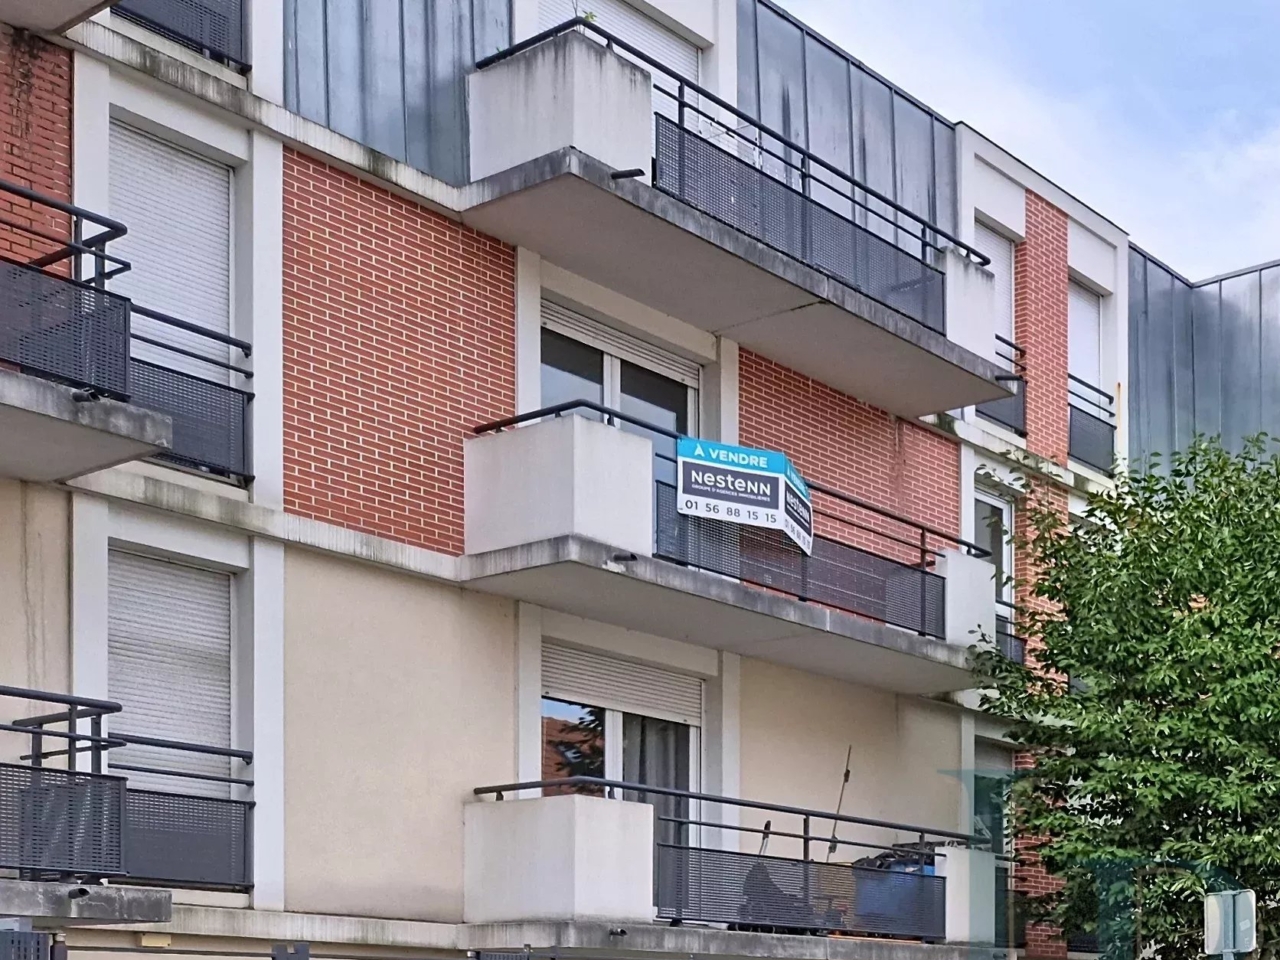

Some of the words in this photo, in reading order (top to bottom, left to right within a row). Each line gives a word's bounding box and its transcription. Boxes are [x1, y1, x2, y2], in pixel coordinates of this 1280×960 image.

[694, 443, 705, 457] À
[709, 448, 768, 468] VENDRE
[685, 500, 698, 510] 01
[705, 503, 720, 514] 56
[726, 507, 740, 517] 88
[747, 510, 759, 520] 15
[765, 513, 777, 523] 15
